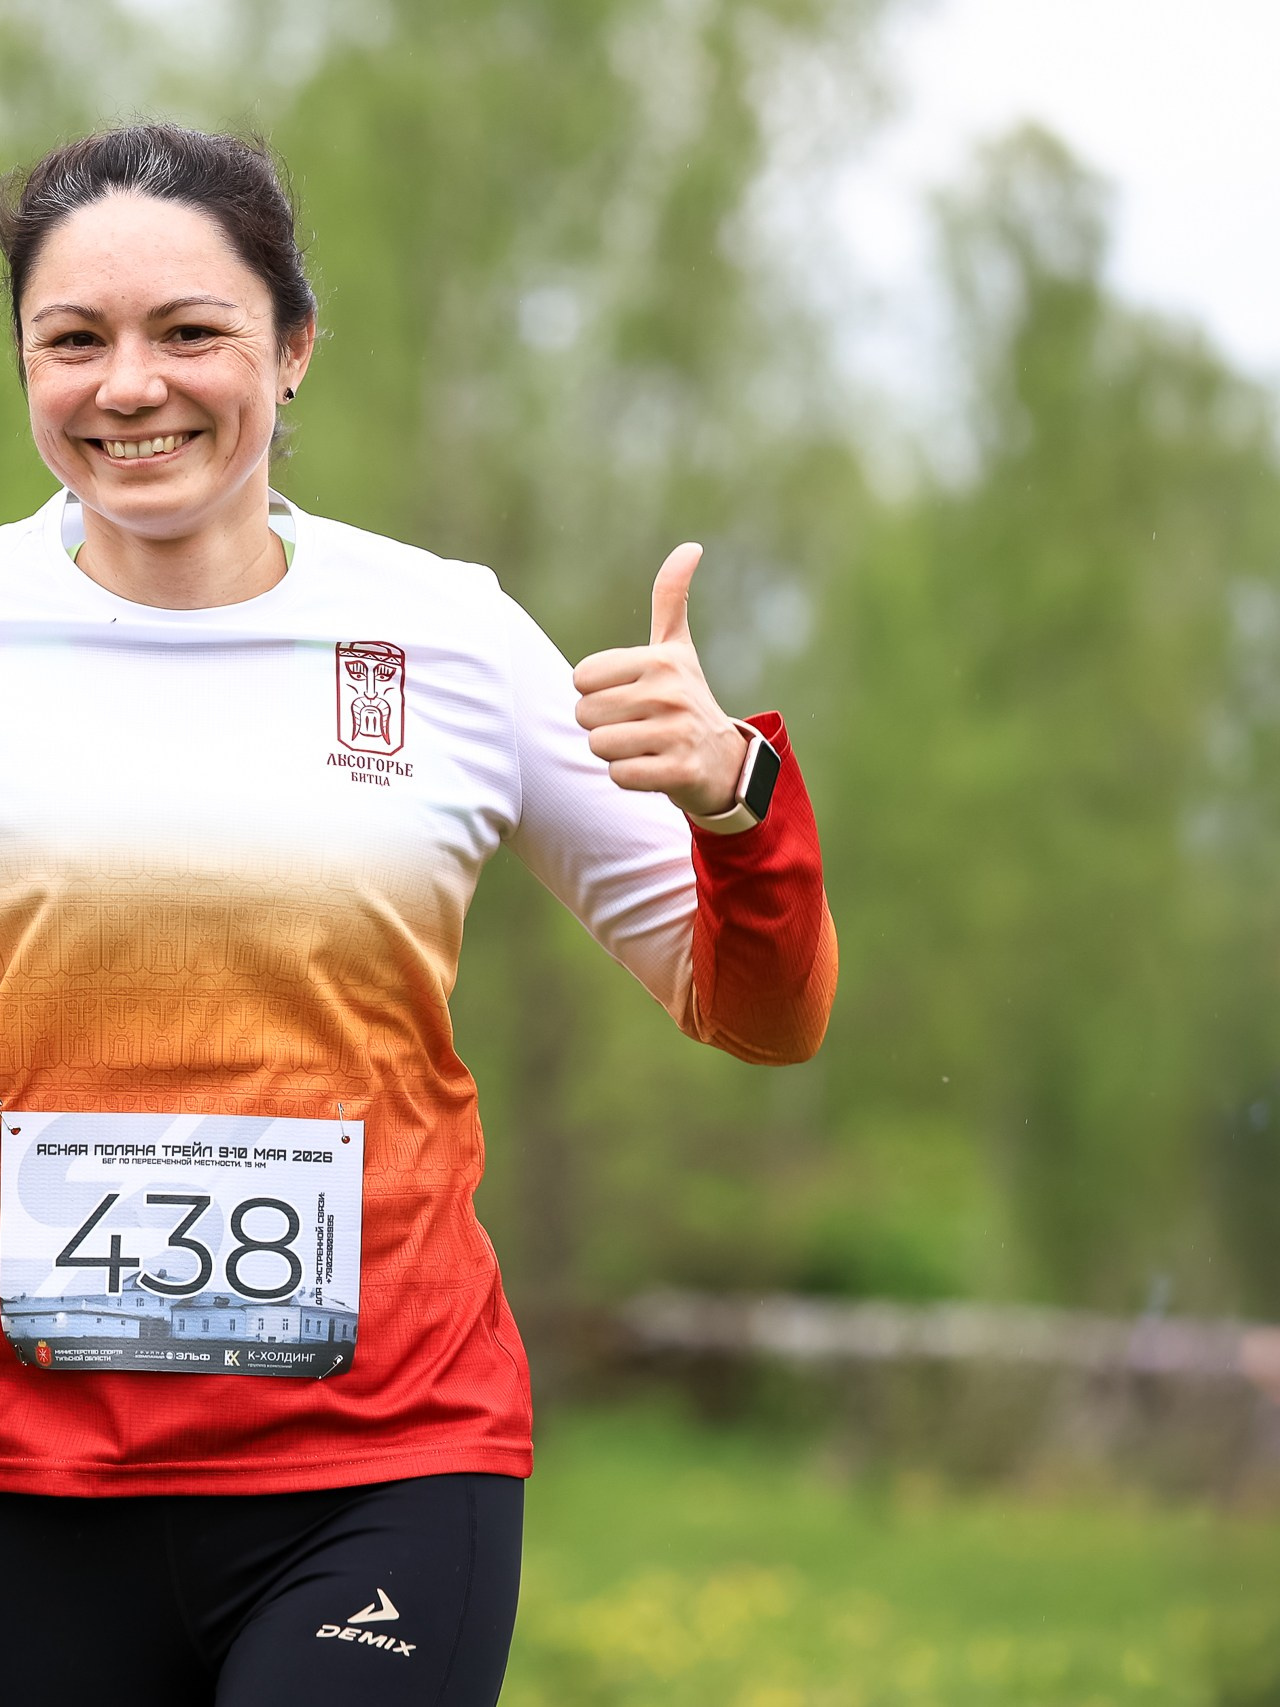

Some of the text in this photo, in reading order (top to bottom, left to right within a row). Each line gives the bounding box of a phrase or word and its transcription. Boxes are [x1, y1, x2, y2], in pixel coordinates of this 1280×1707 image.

[351, 771, 390, 787] БИТЦА
[36, 1141, 333, 1163] ЯСНАЯ ПОЛЯНА ТРЕЙЛ 9-10 МАЯ 2026
[131, 1157, 192, 1166] ПЕРЕСЕЧЕННОЙ
[55, 1193, 303, 1299] 438
[315, 1191, 325, 1306] ДЛЯ ЭКСТРЕННОЙ СВЯЗИ:
[176, 1352, 211, 1361] ЭЛЬФ
[248, 1351, 316, 1363] К-ХОЛДИНГ
[316, 1624, 417, 1657] DEMIX
